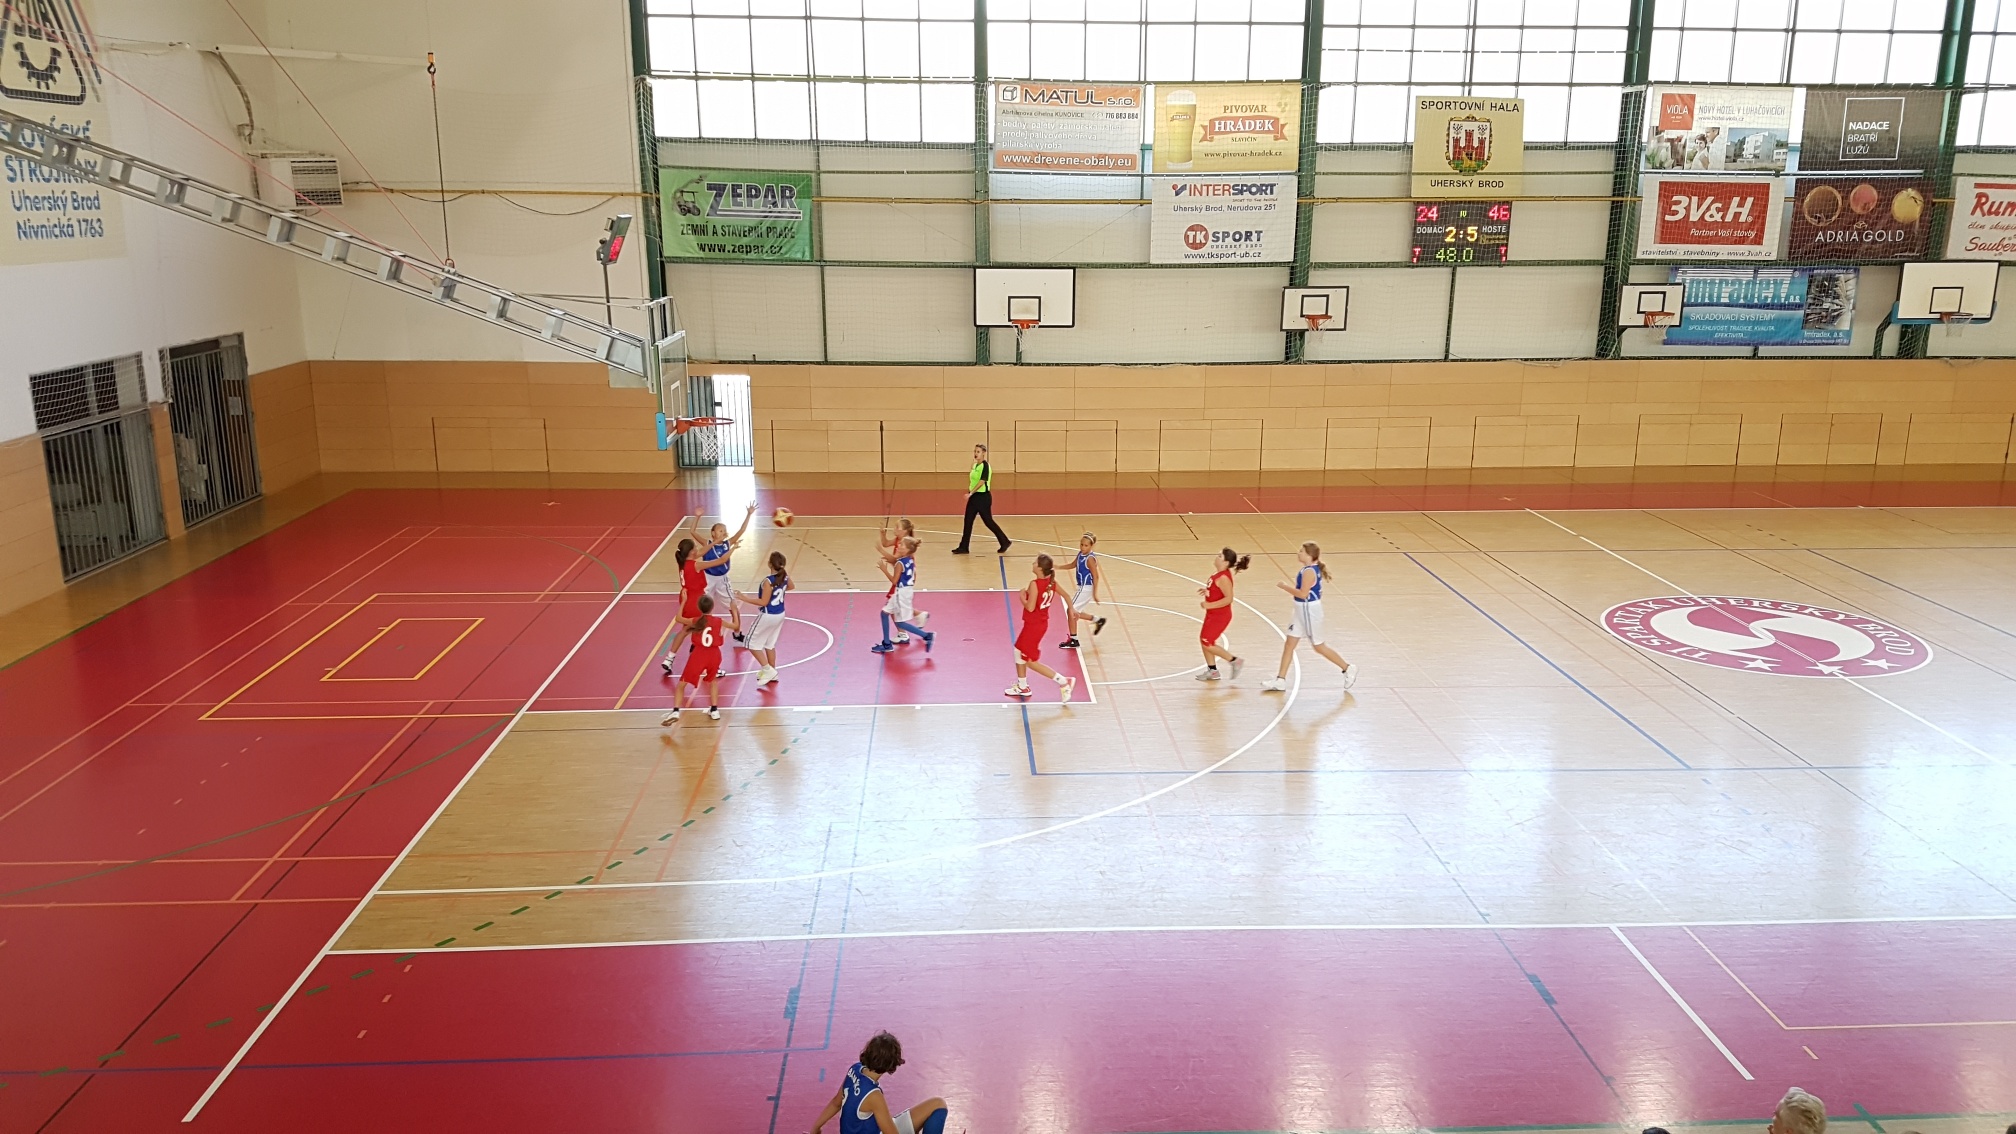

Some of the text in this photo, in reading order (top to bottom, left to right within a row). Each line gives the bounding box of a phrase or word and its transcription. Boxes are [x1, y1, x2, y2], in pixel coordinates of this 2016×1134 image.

[1024, 88, 1135, 106] MATUL s.r.o.
[1223, 104, 1267, 114] PIVOVAR
[1421, 100, 1520, 112] SPORTOVNÍ HALA
[1666, 104, 1689, 115] VIOLA
[1716, 105, 1735, 115] HOTEL
[1737, 105, 1742, 115] V
[1214, 118, 1274, 132] HRÁDEK
[1849, 121, 1890, 130] NADACE
[1847, 132, 1878, 142] BRATŘÍ
[1003, 153, 1132, 168] www.drevene-obaly.eu
[1204, 150, 1282, 158] www.pivovar-hradek.cz
[1189, 183, 1277, 196] INTERSPORT
[1430, 179, 1504, 188] UHERSKÝ BROD
[11, 189, 100, 216] Uherský Brod
[705, 182, 802, 220] ZEPAR
[1173, 204, 1203, 213] Uherský
[1205, 204, 1225, 212] Brod,
[1416, 205, 1438, 221] 24
[1488, 204, 1510, 221] 46
[16, 217, 104, 240] Nivnická 1763
[681, 221, 709, 236] ZEMNÍ
[712, 224, 719, 237] A
[1690, 228, 1717, 237] Partner
[1734, 229, 1757, 238] stavby
[1187, 230, 1263, 243] TK SPORT
[1815, 229, 1905, 242] ADRIA GOLD
[697, 242, 783, 256] www.zepar.cz
[1184, 251, 1262, 260] www.tksport-ub.cz
[1435, 247, 1474, 262] 48.0
[1641, 248, 1678, 256] stavitelství
[1682, 249, 1720, 257] stavebniny
[1040, 590, 1054, 610] 22
[1613, 600, 1672, 646] SPARTAK
[701, 626, 713, 648] 6
[1852, 623, 1915, 656] BROD
[1666, 646, 1712, 660] TJ
